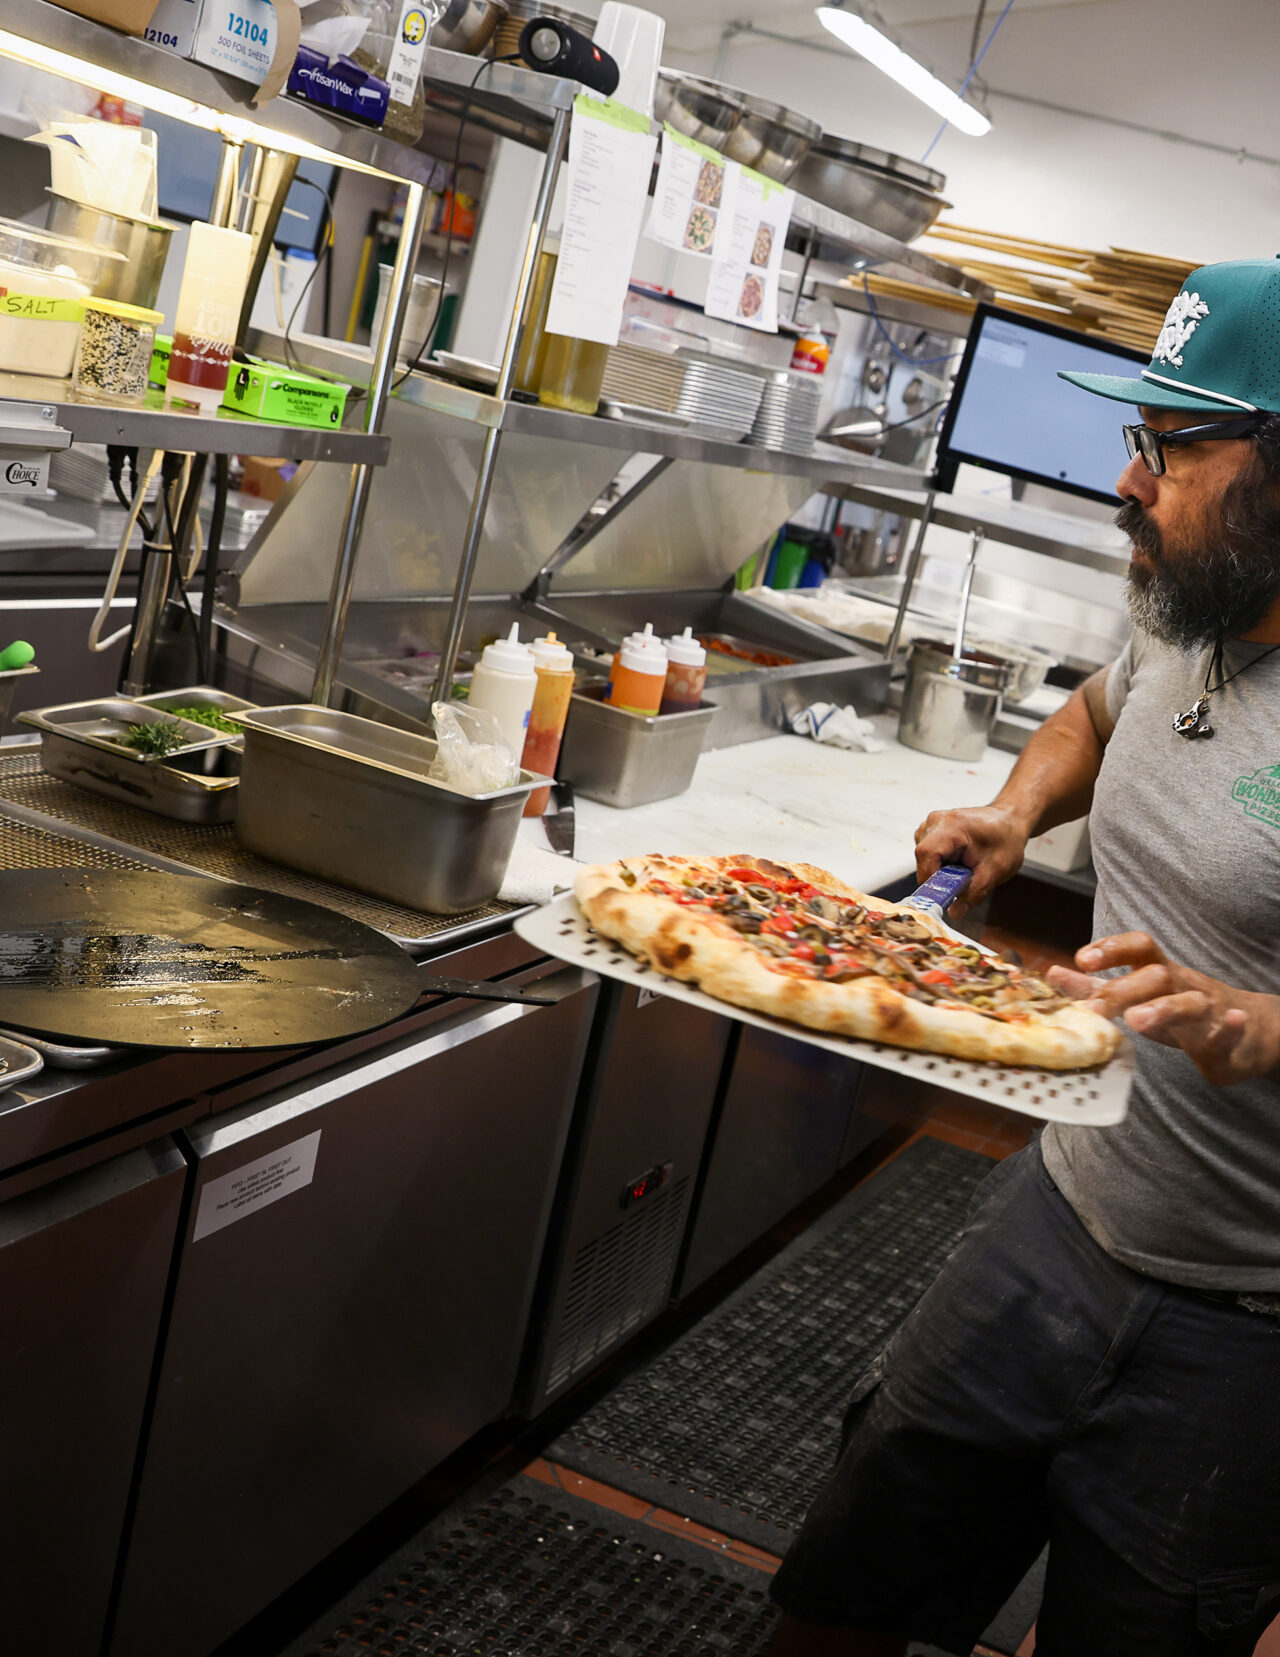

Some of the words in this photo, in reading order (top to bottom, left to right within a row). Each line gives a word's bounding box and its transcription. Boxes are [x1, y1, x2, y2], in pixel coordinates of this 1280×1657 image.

[143, 27, 179, 48] 12104
[227, 12, 269, 47] 12104
[216, 35, 231, 48] 500
[231, 40, 247, 55] FOIL
[247, 48, 270, 64] SHEETS
[297, 67, 354, 97] ArtisanWax
[6, 296, 67, 315] SALT
[238, 372, 245, 385] L
[5, 462, 41, 487] CHOICE
[247, 1170, 261, 1181] FIRST
[268, 1161, 281, 1171] FIRST
[281, 1156, 292, 1167] OUT
[239, 1189, 255, 1201] product
[285, 1165, 301, 1177] product
